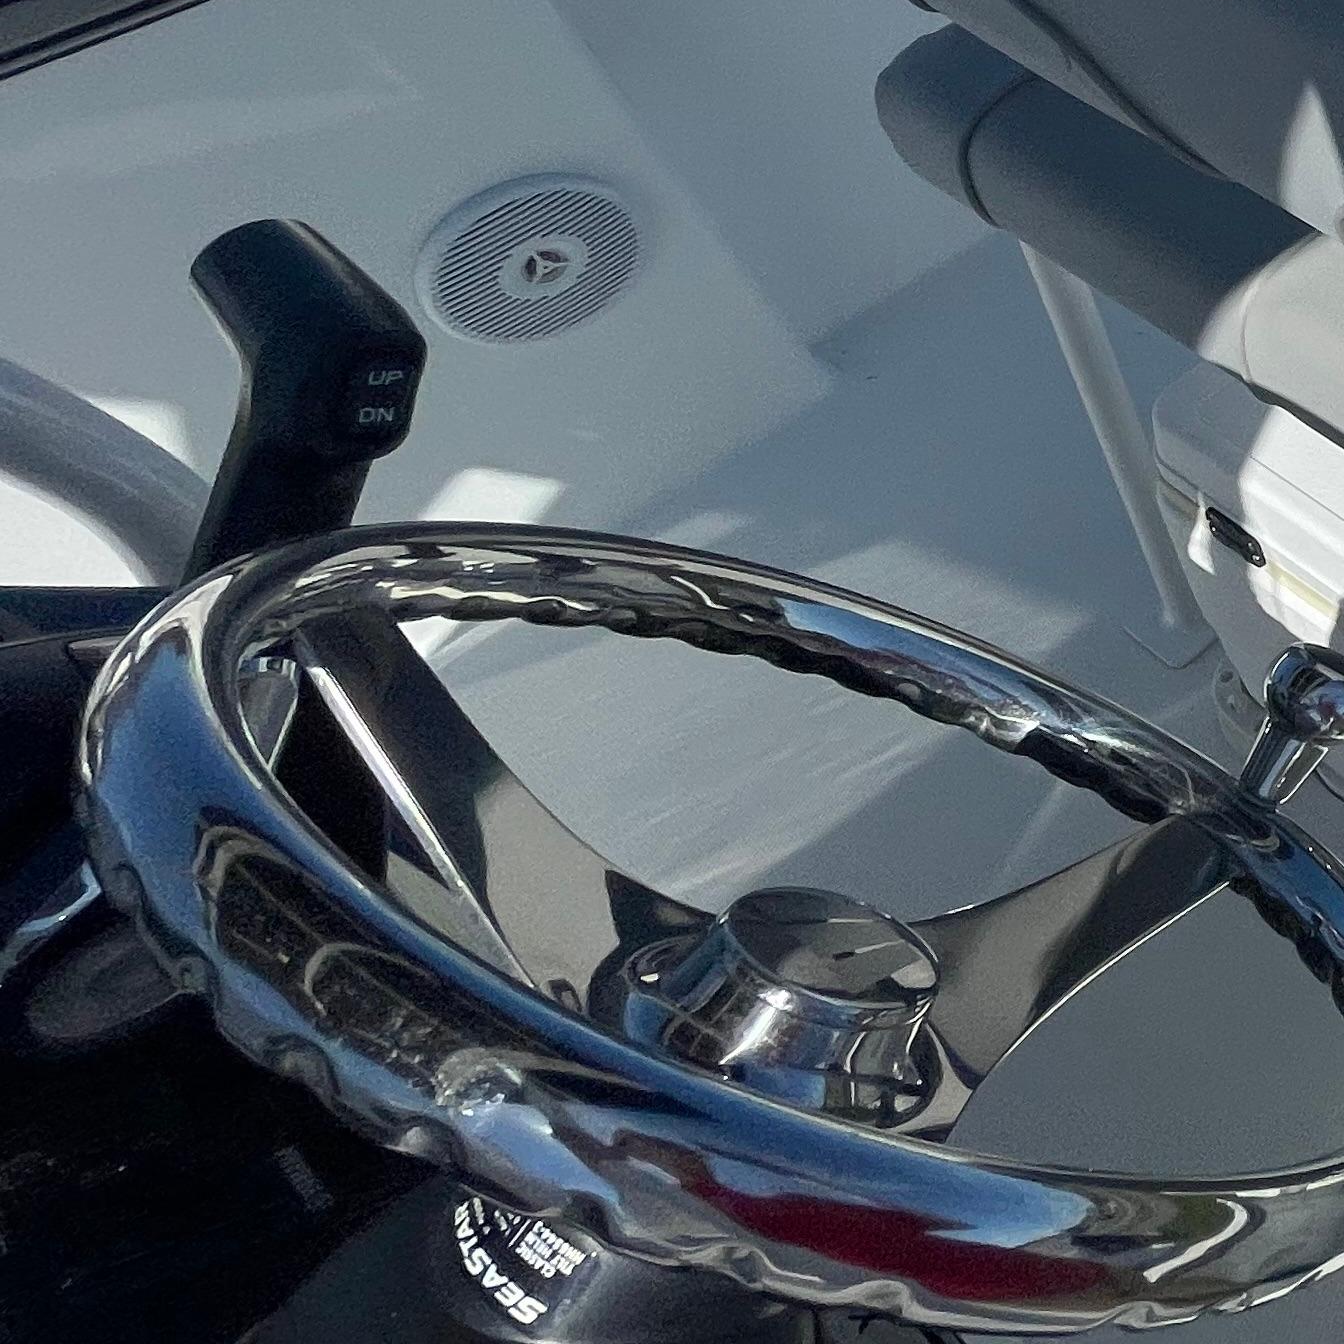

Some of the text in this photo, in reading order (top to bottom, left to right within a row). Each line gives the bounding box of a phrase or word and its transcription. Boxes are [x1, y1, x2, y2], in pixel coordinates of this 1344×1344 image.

[368, 370, 403, 386] UP
[359, 407, 396, 424] DN
[454, 1200, 549, 1325] SEASTAR
